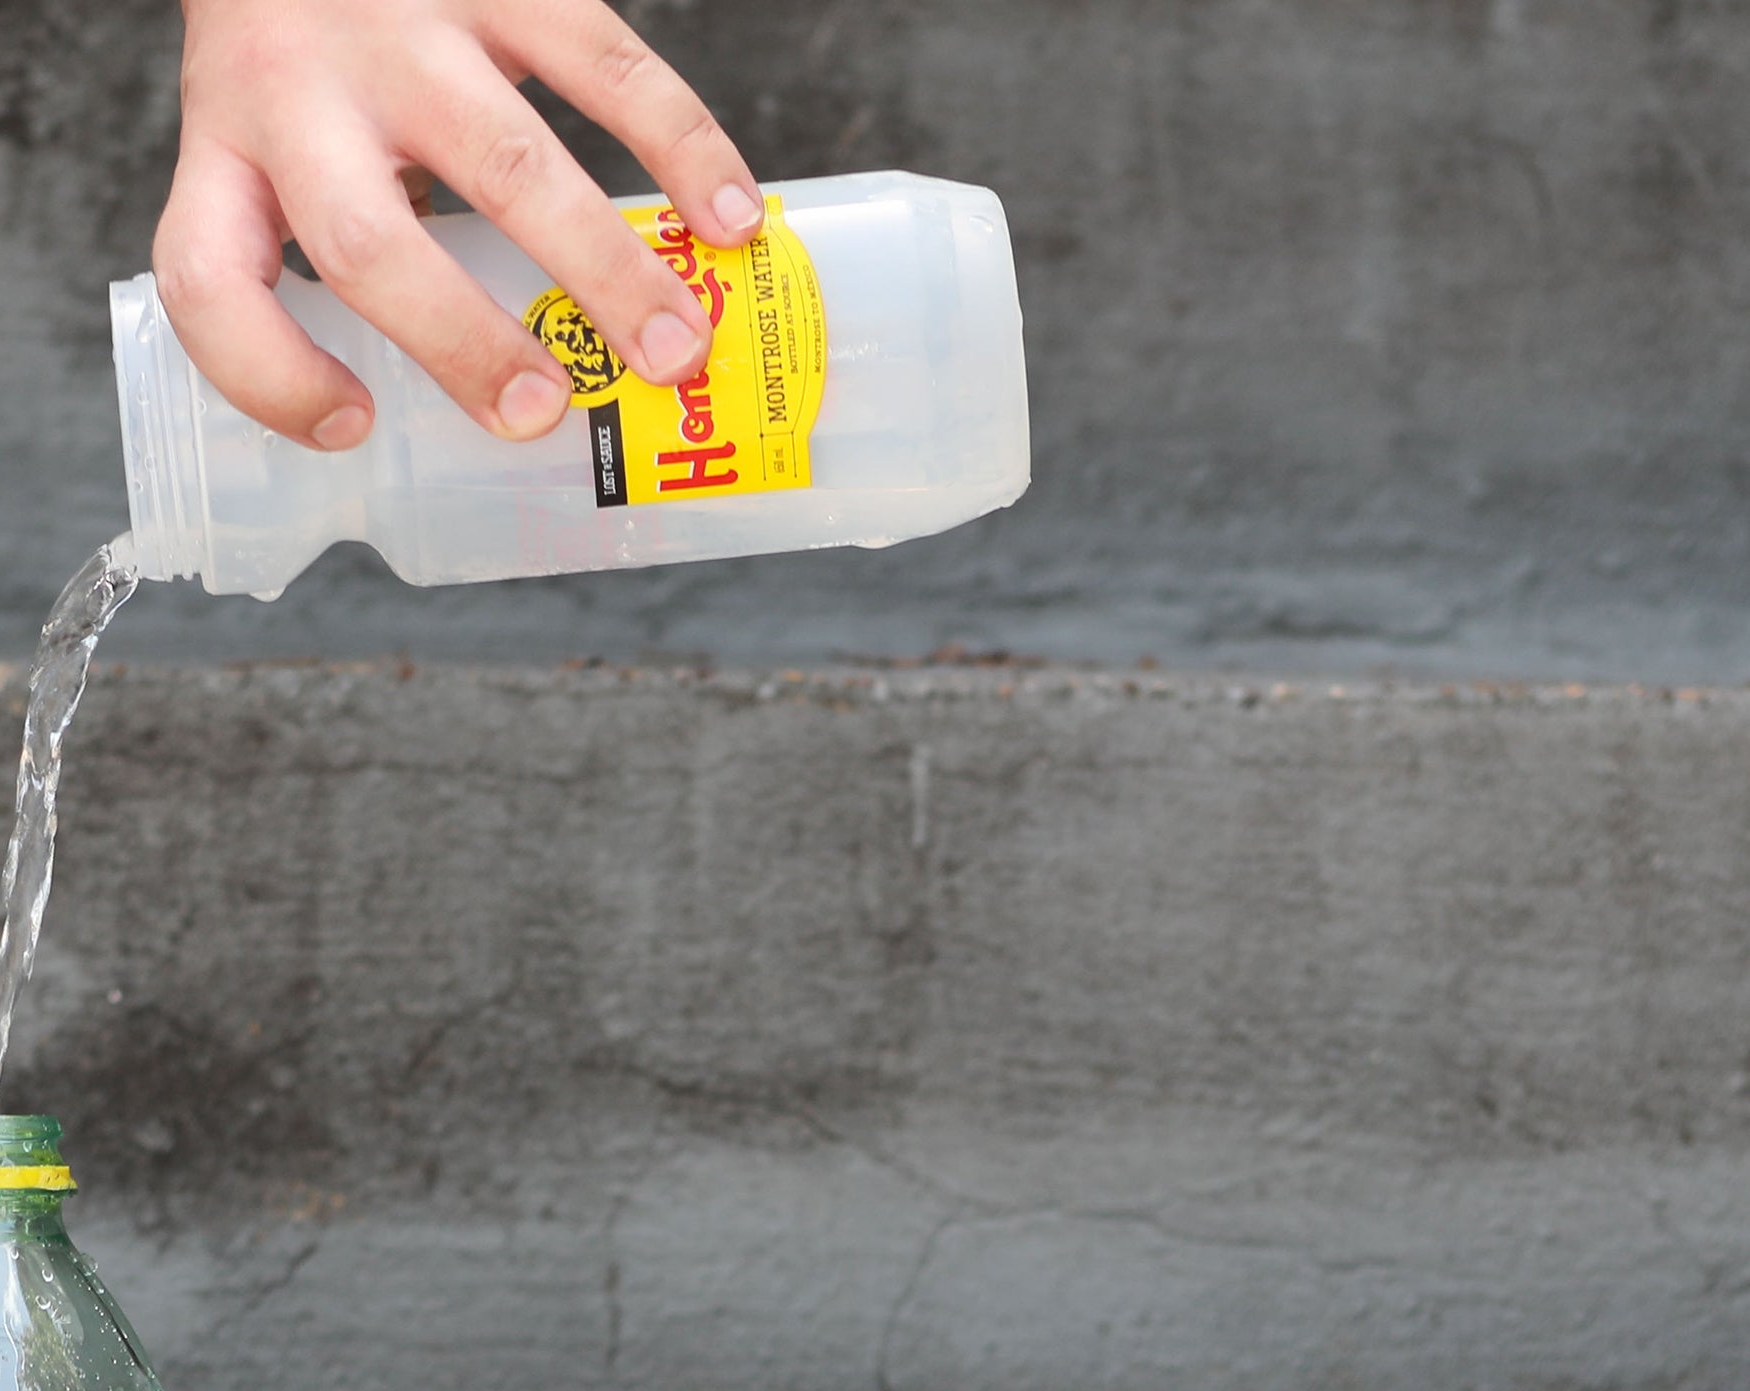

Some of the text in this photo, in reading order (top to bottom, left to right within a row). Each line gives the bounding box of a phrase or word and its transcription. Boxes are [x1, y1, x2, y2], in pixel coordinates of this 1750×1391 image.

[750, 237, 787, 424] MONTROSE WATER
[781, 273, 798, 374] BOTTLED AT SOURCE
[811, 302, 819, 314] TO
[812, 318, 822, 373] MONTROSE
[604, 470, 616, 495] LOST
